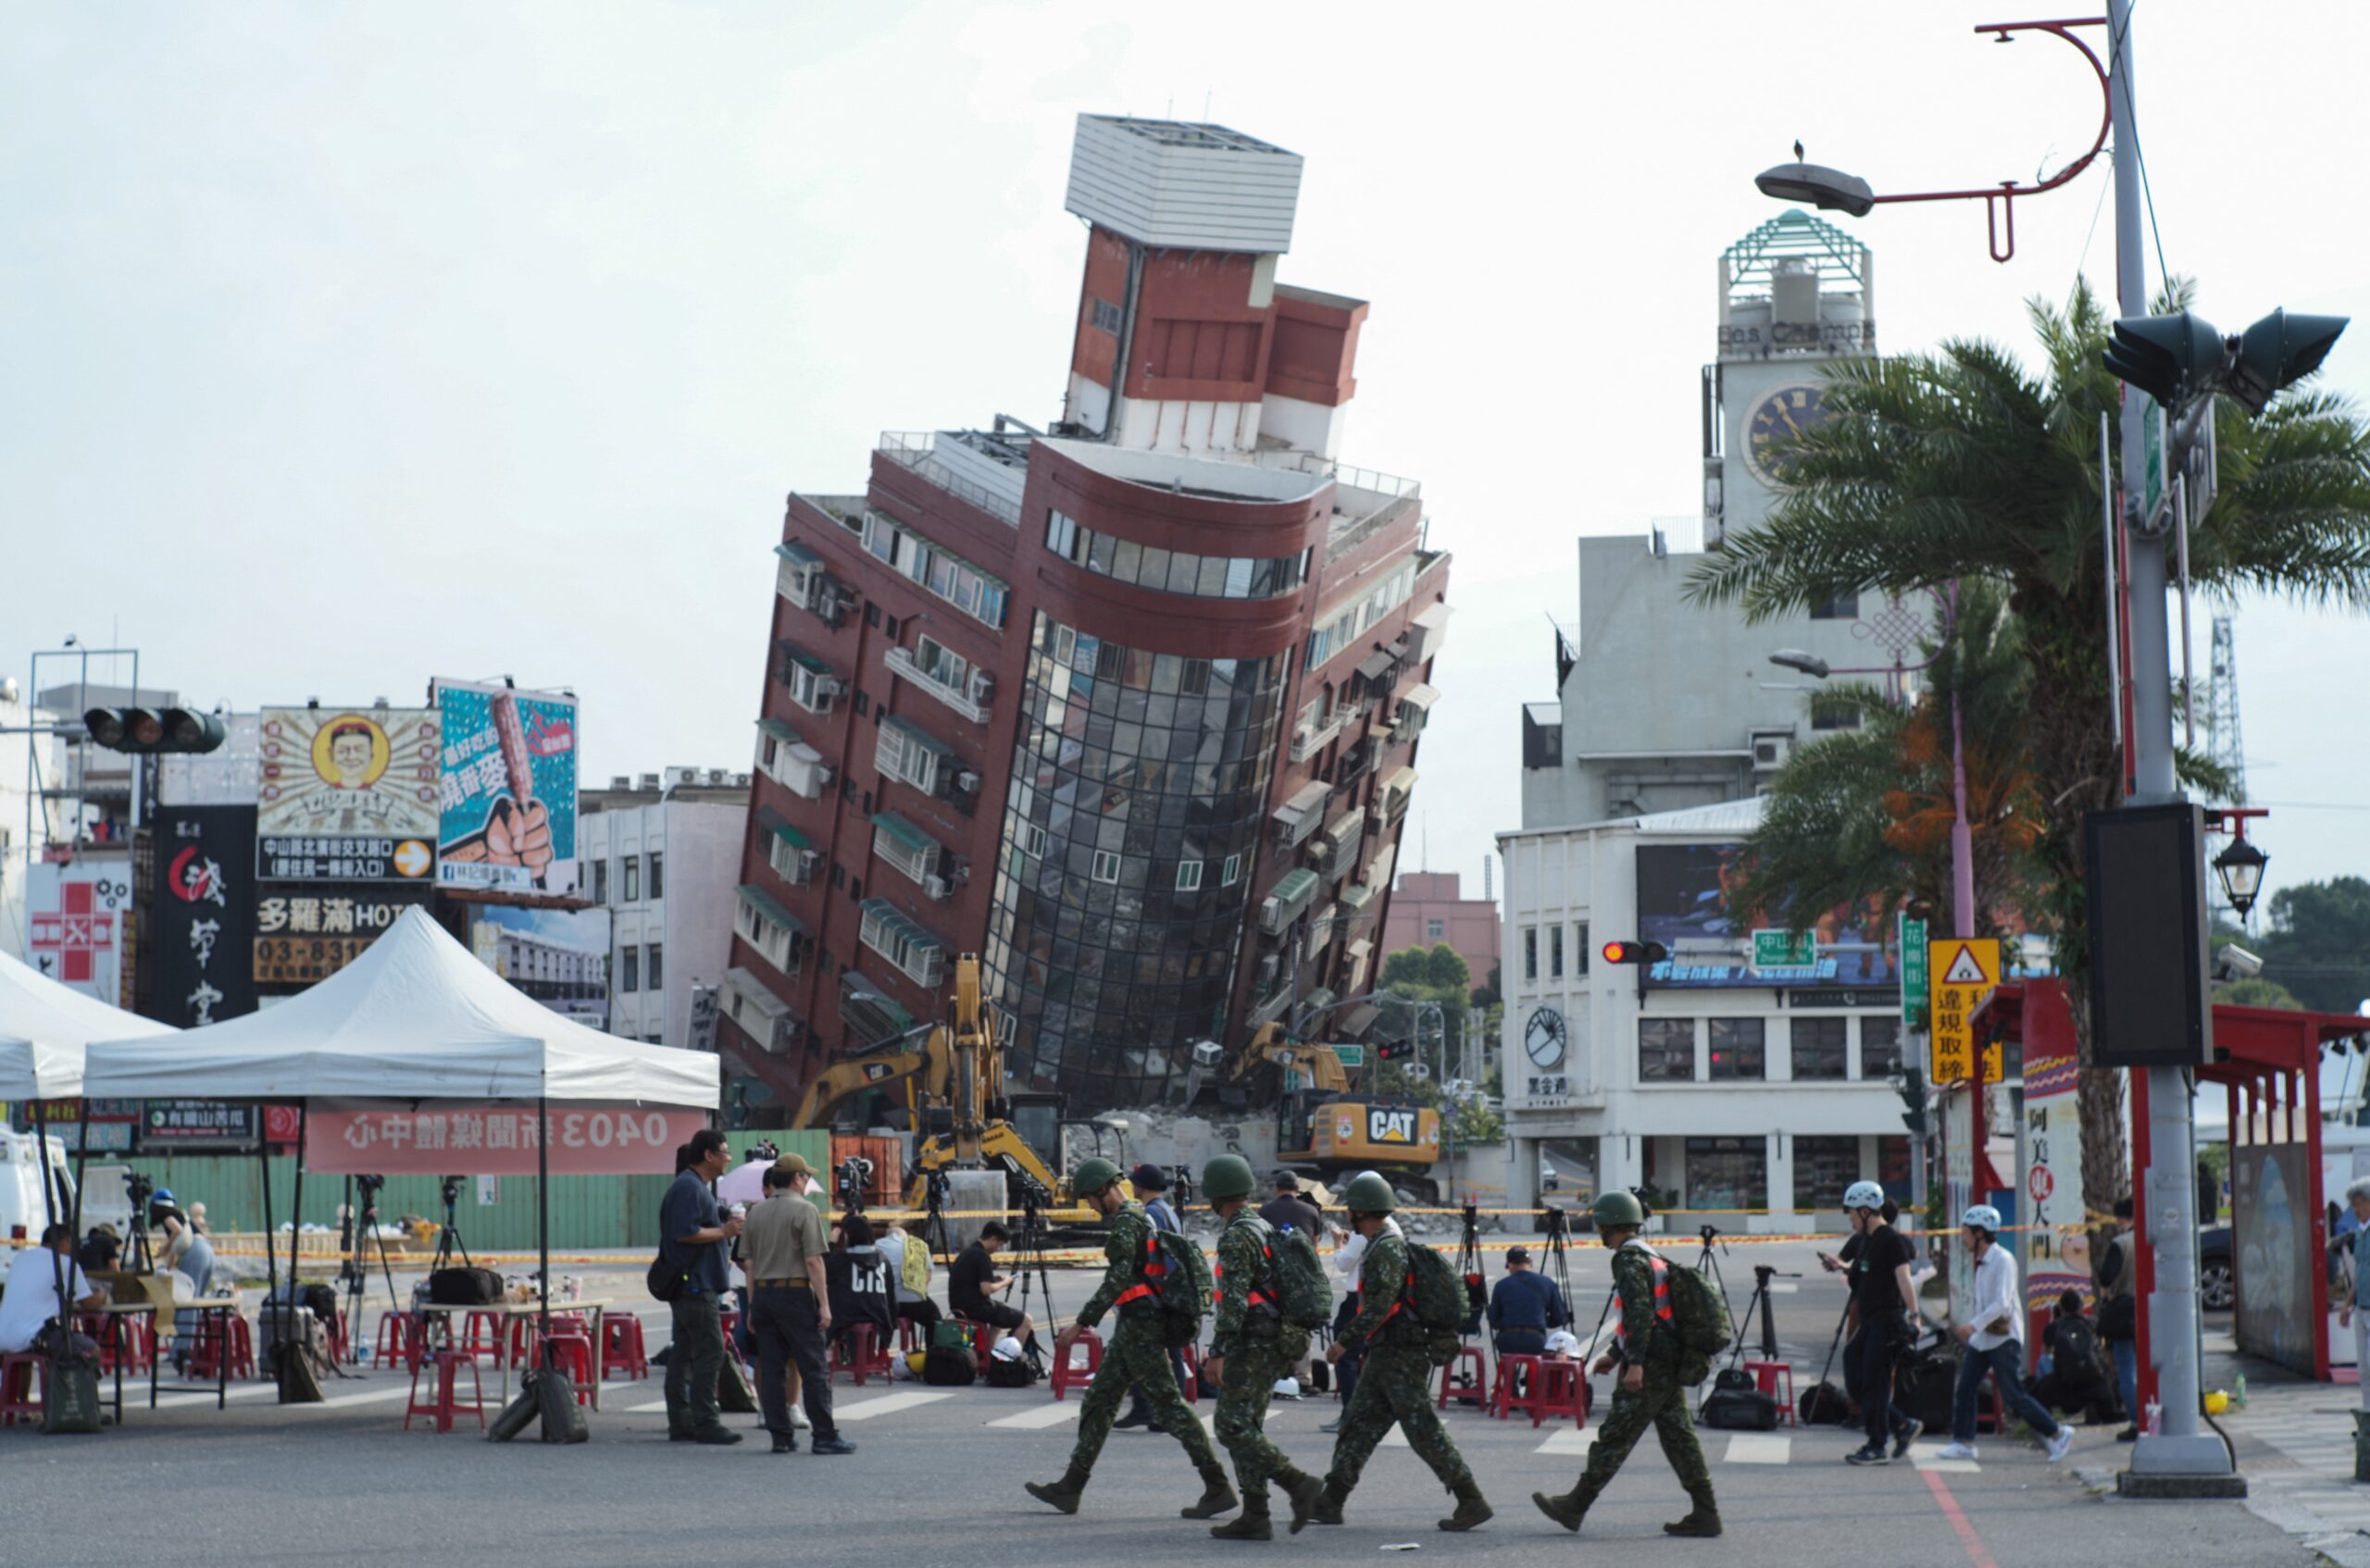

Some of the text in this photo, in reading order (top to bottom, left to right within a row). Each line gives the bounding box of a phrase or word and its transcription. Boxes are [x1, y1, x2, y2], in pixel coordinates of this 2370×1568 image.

[256, 897, 425, 933] 多羅滿 HOT
[1938, 988, 1964, 1080] 違規取締
[1370, 1110, 1415, 1142] CAT
[2028, 1106, 2054, 1260] 阿美東大門
